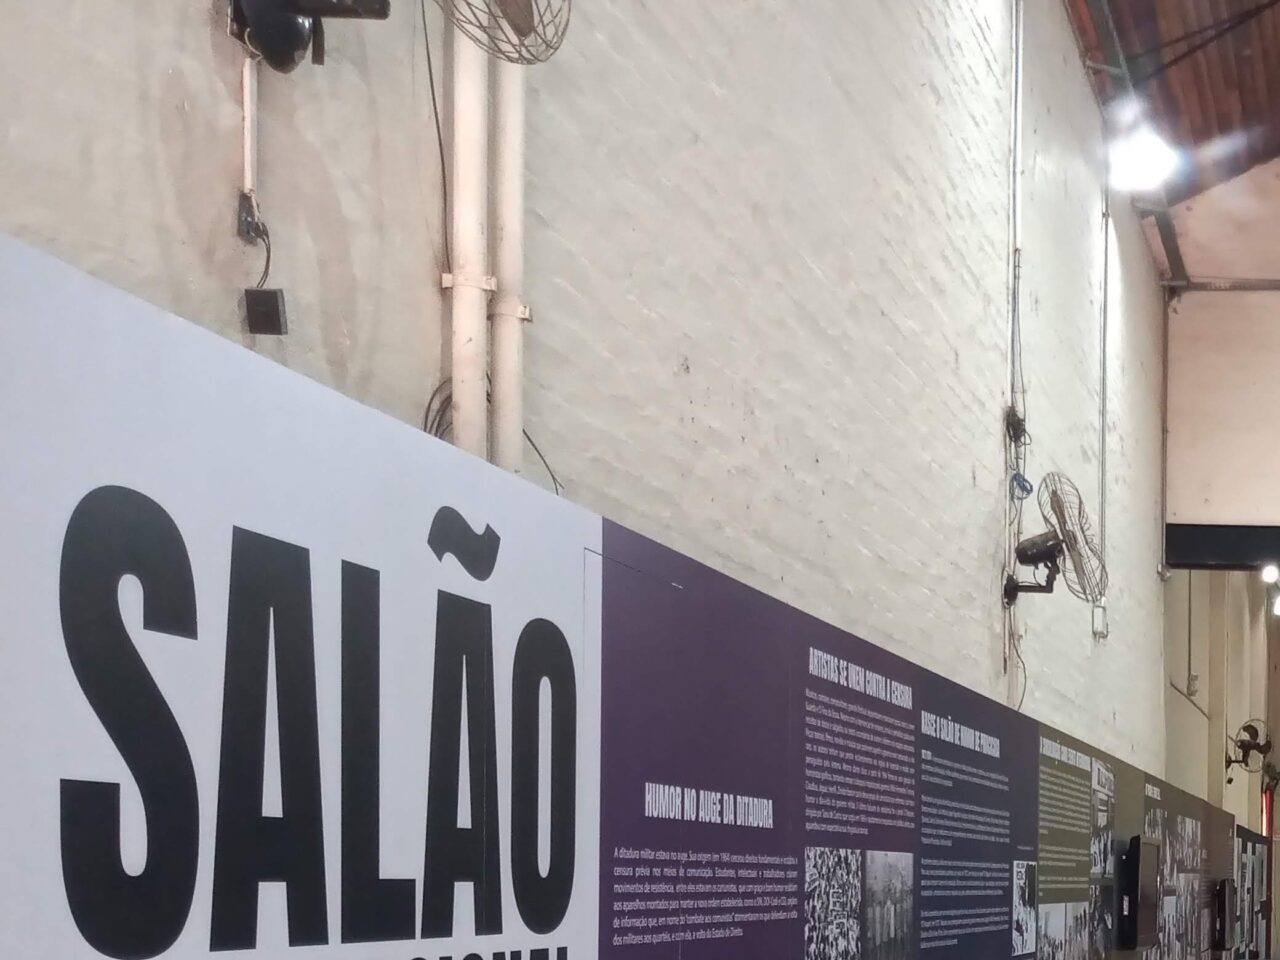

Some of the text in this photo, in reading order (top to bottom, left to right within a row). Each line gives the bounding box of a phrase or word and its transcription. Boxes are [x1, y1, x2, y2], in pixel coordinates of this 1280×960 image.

[59, 485, 577, 960] SALÃO
[645, 782, 774, 829] HUMOR NO AUGE DA DITADURA
